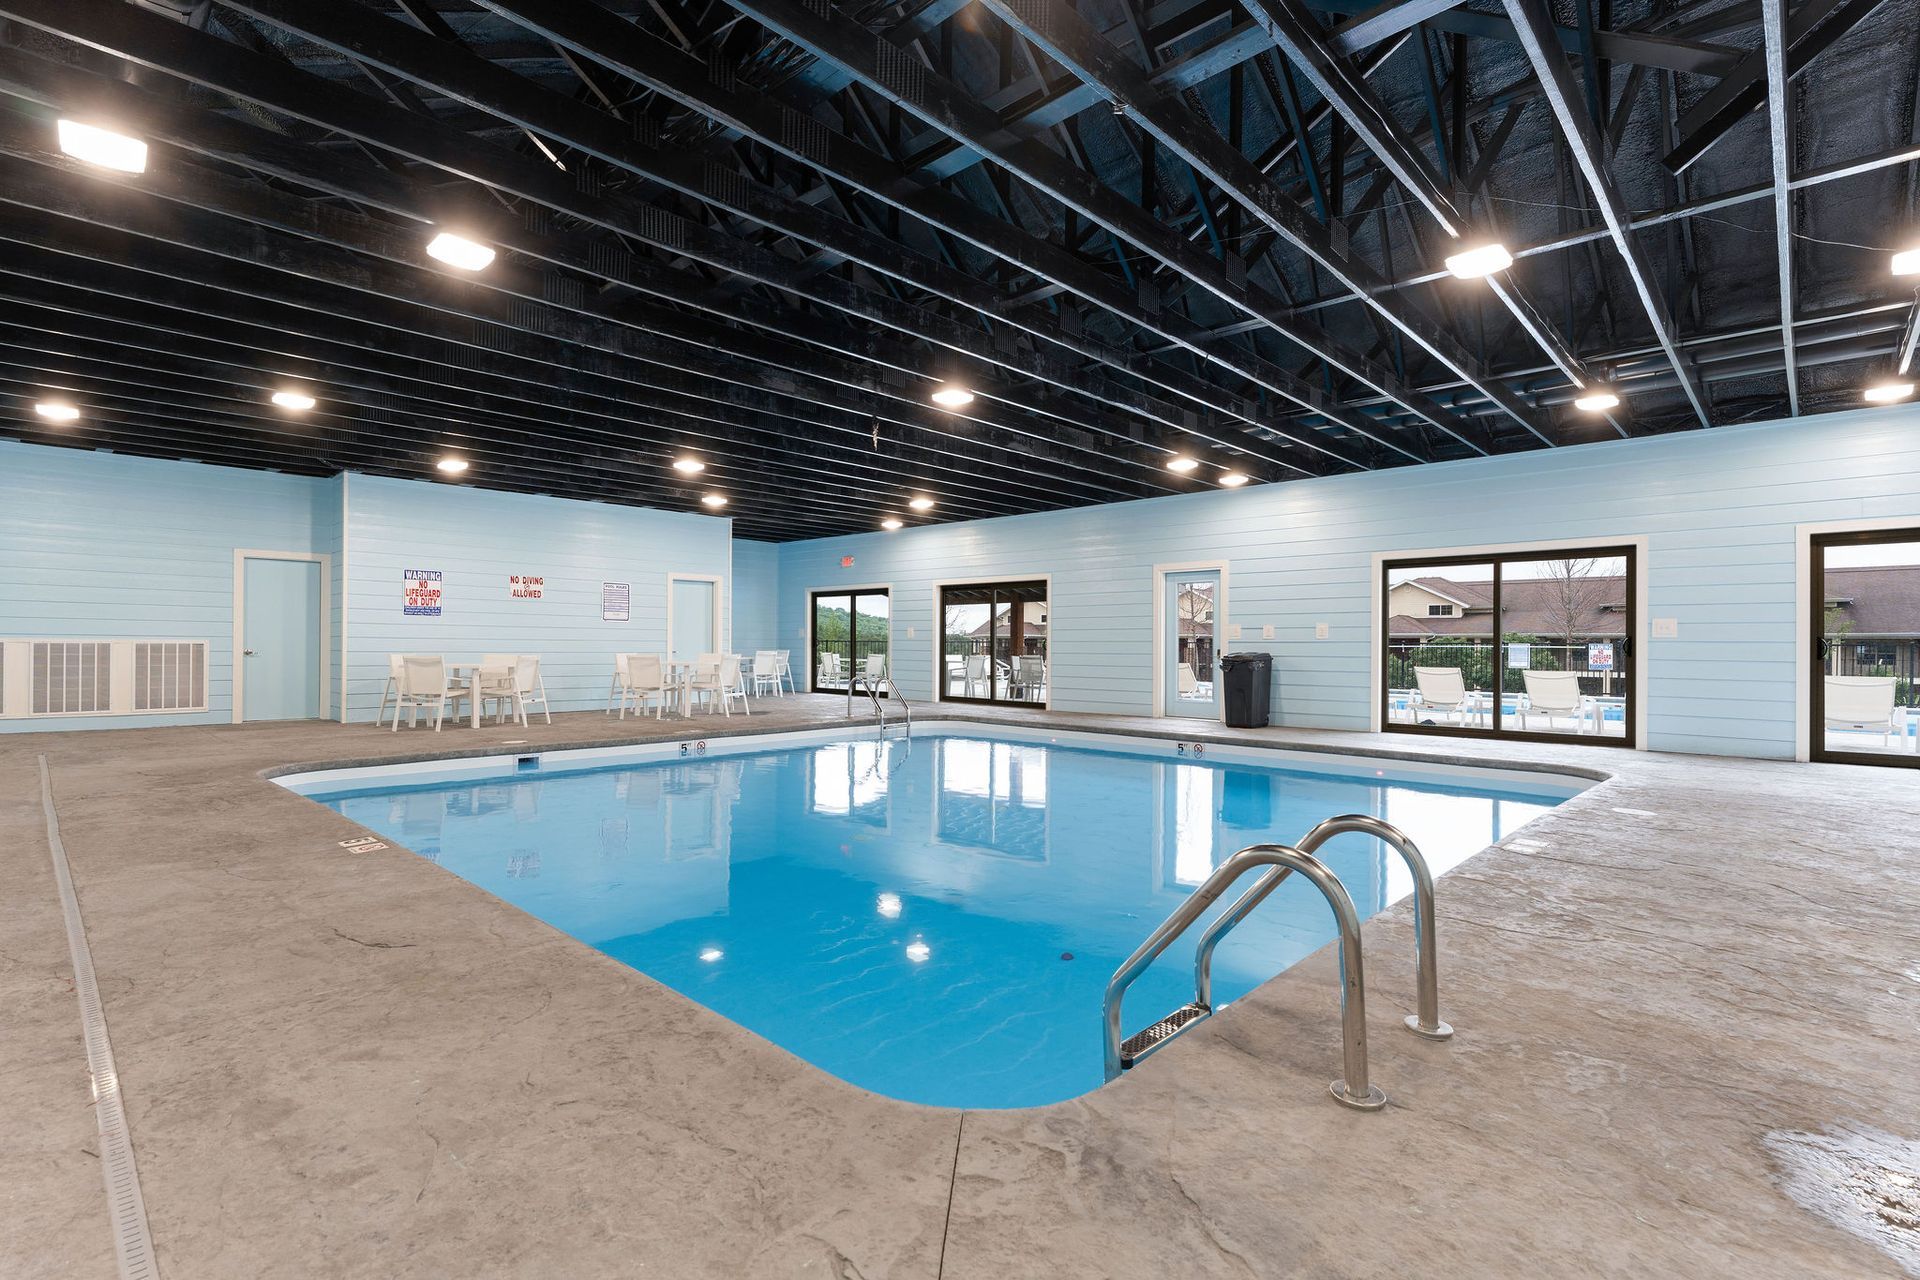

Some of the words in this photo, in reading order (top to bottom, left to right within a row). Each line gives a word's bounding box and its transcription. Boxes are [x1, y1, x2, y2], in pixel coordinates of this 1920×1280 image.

[405, 570, 441, 580] WARNING
[418, 580, 428, 588] NO
[510, 576, 520, 584] NO
[522, 576, 544, 585] DIVING
[406, 588, 440, 598] LIFEGUARD
[512, 589, 542, 598] ALLOWED
[408, 597, 418, 606] ON
[420, 598, 437, 606] DUTY
[681, 743, 688, 751] 5
